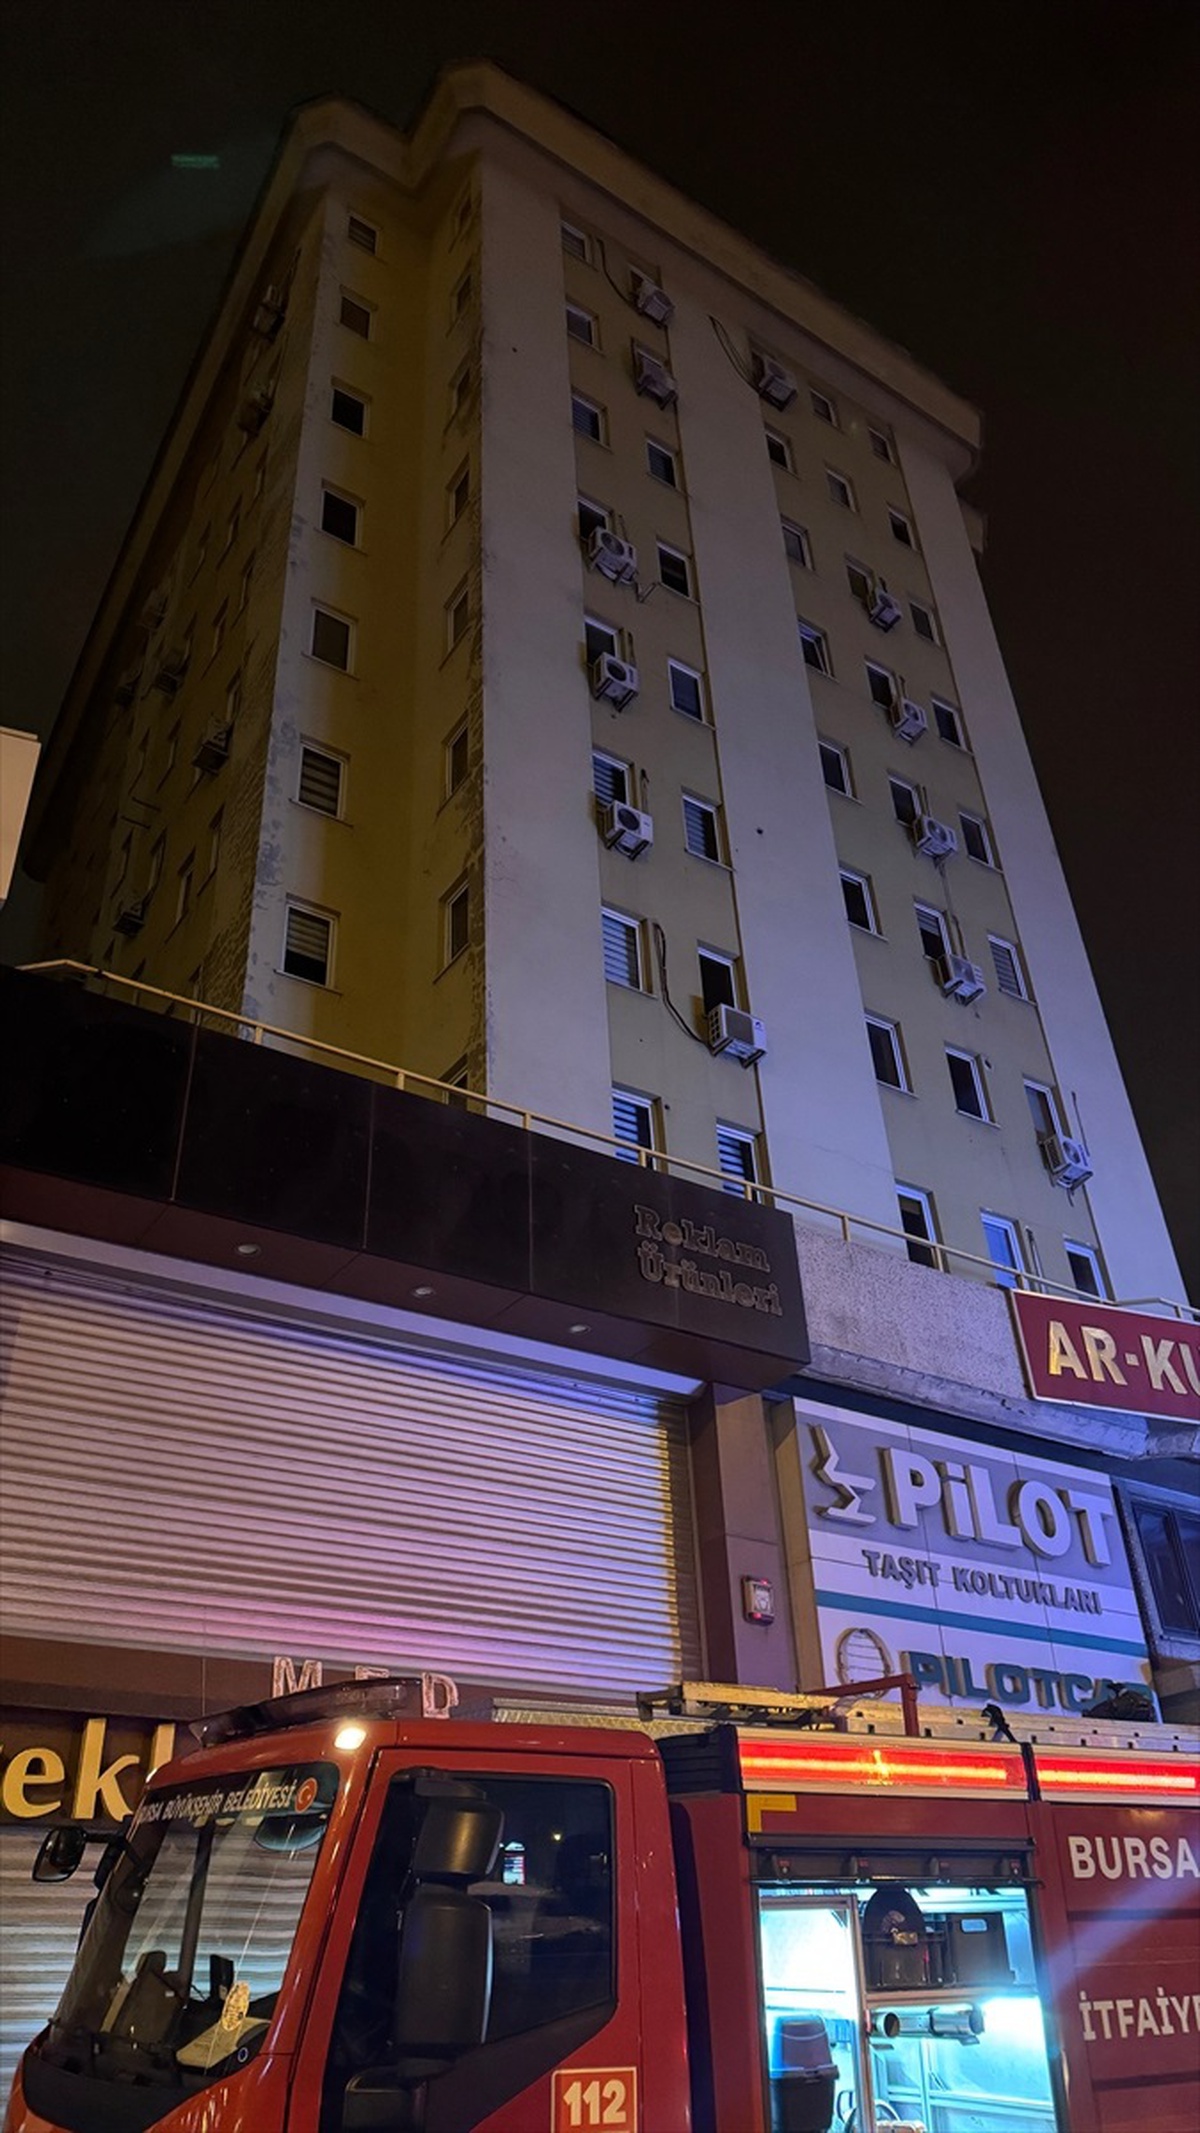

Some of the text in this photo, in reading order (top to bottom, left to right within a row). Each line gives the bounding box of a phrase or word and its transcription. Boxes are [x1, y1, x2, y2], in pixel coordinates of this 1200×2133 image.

[634, 1204, 770, 1272] Reklam
[637, 1240, 783, 1316] Ürünleri
[862, 1551, 1102, 1614] TAŞIT KOLTUKLARI
[224, 1780, 297, 1812] BELEDİYESİ
[1067, 1836, 1200, 1879] BURSA
[563, 2079, 626, 2126] 112
